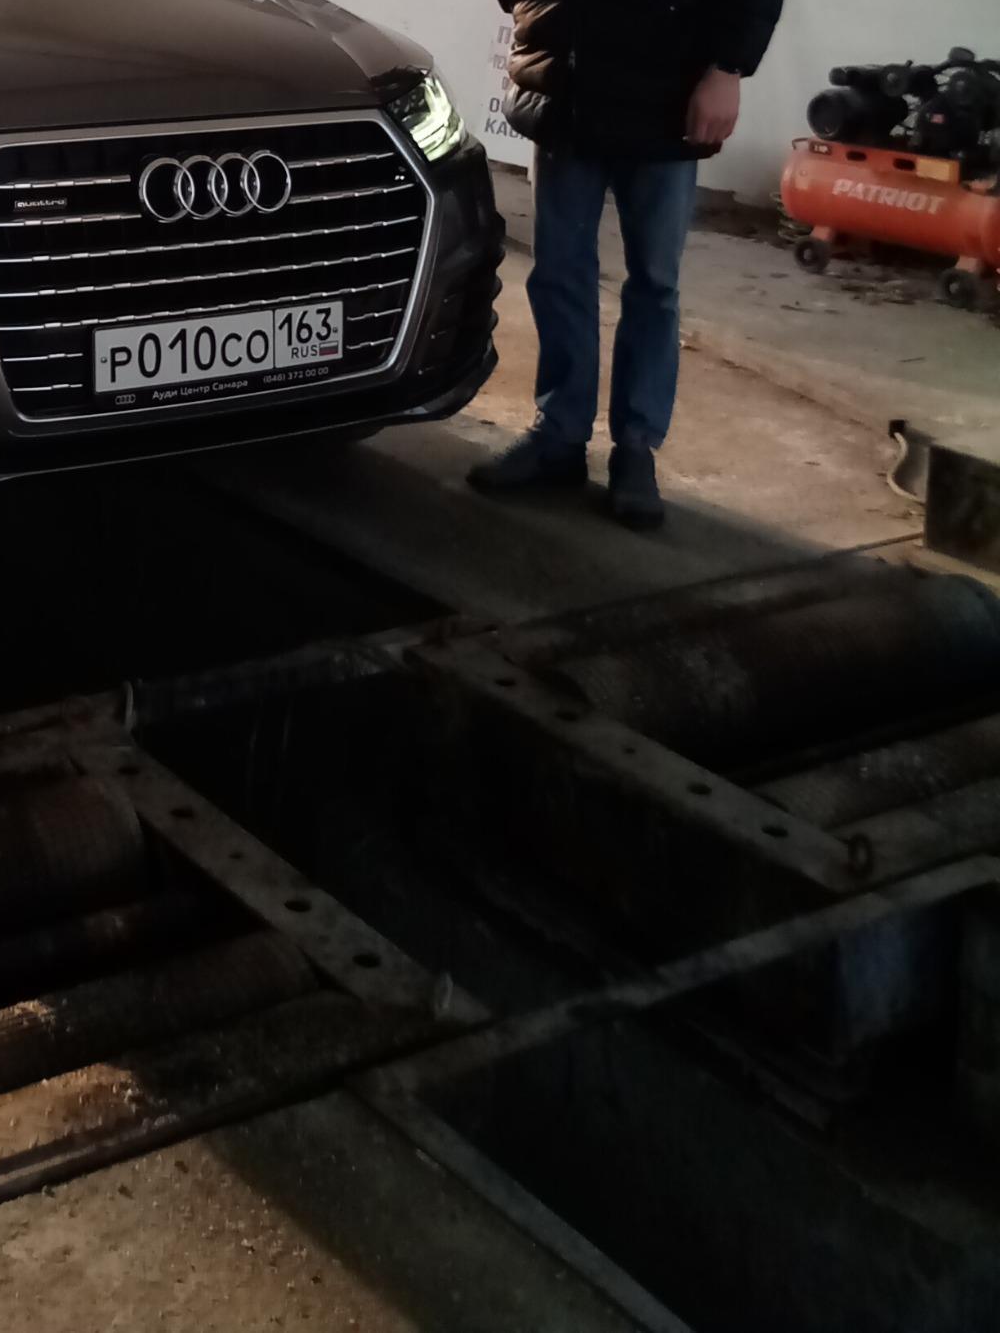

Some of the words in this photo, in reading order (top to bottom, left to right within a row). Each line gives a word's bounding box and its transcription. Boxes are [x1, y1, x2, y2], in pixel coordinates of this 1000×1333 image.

[831, 178, 945, 215] PATRIOT
[278, 307, 332, 347] 163
[290, 345, 318, 359] RUS
[152, 390, 178, 401] Ауди
[180, 384, 210, 397] Центр
[212, 379, 249, 392] Самара
